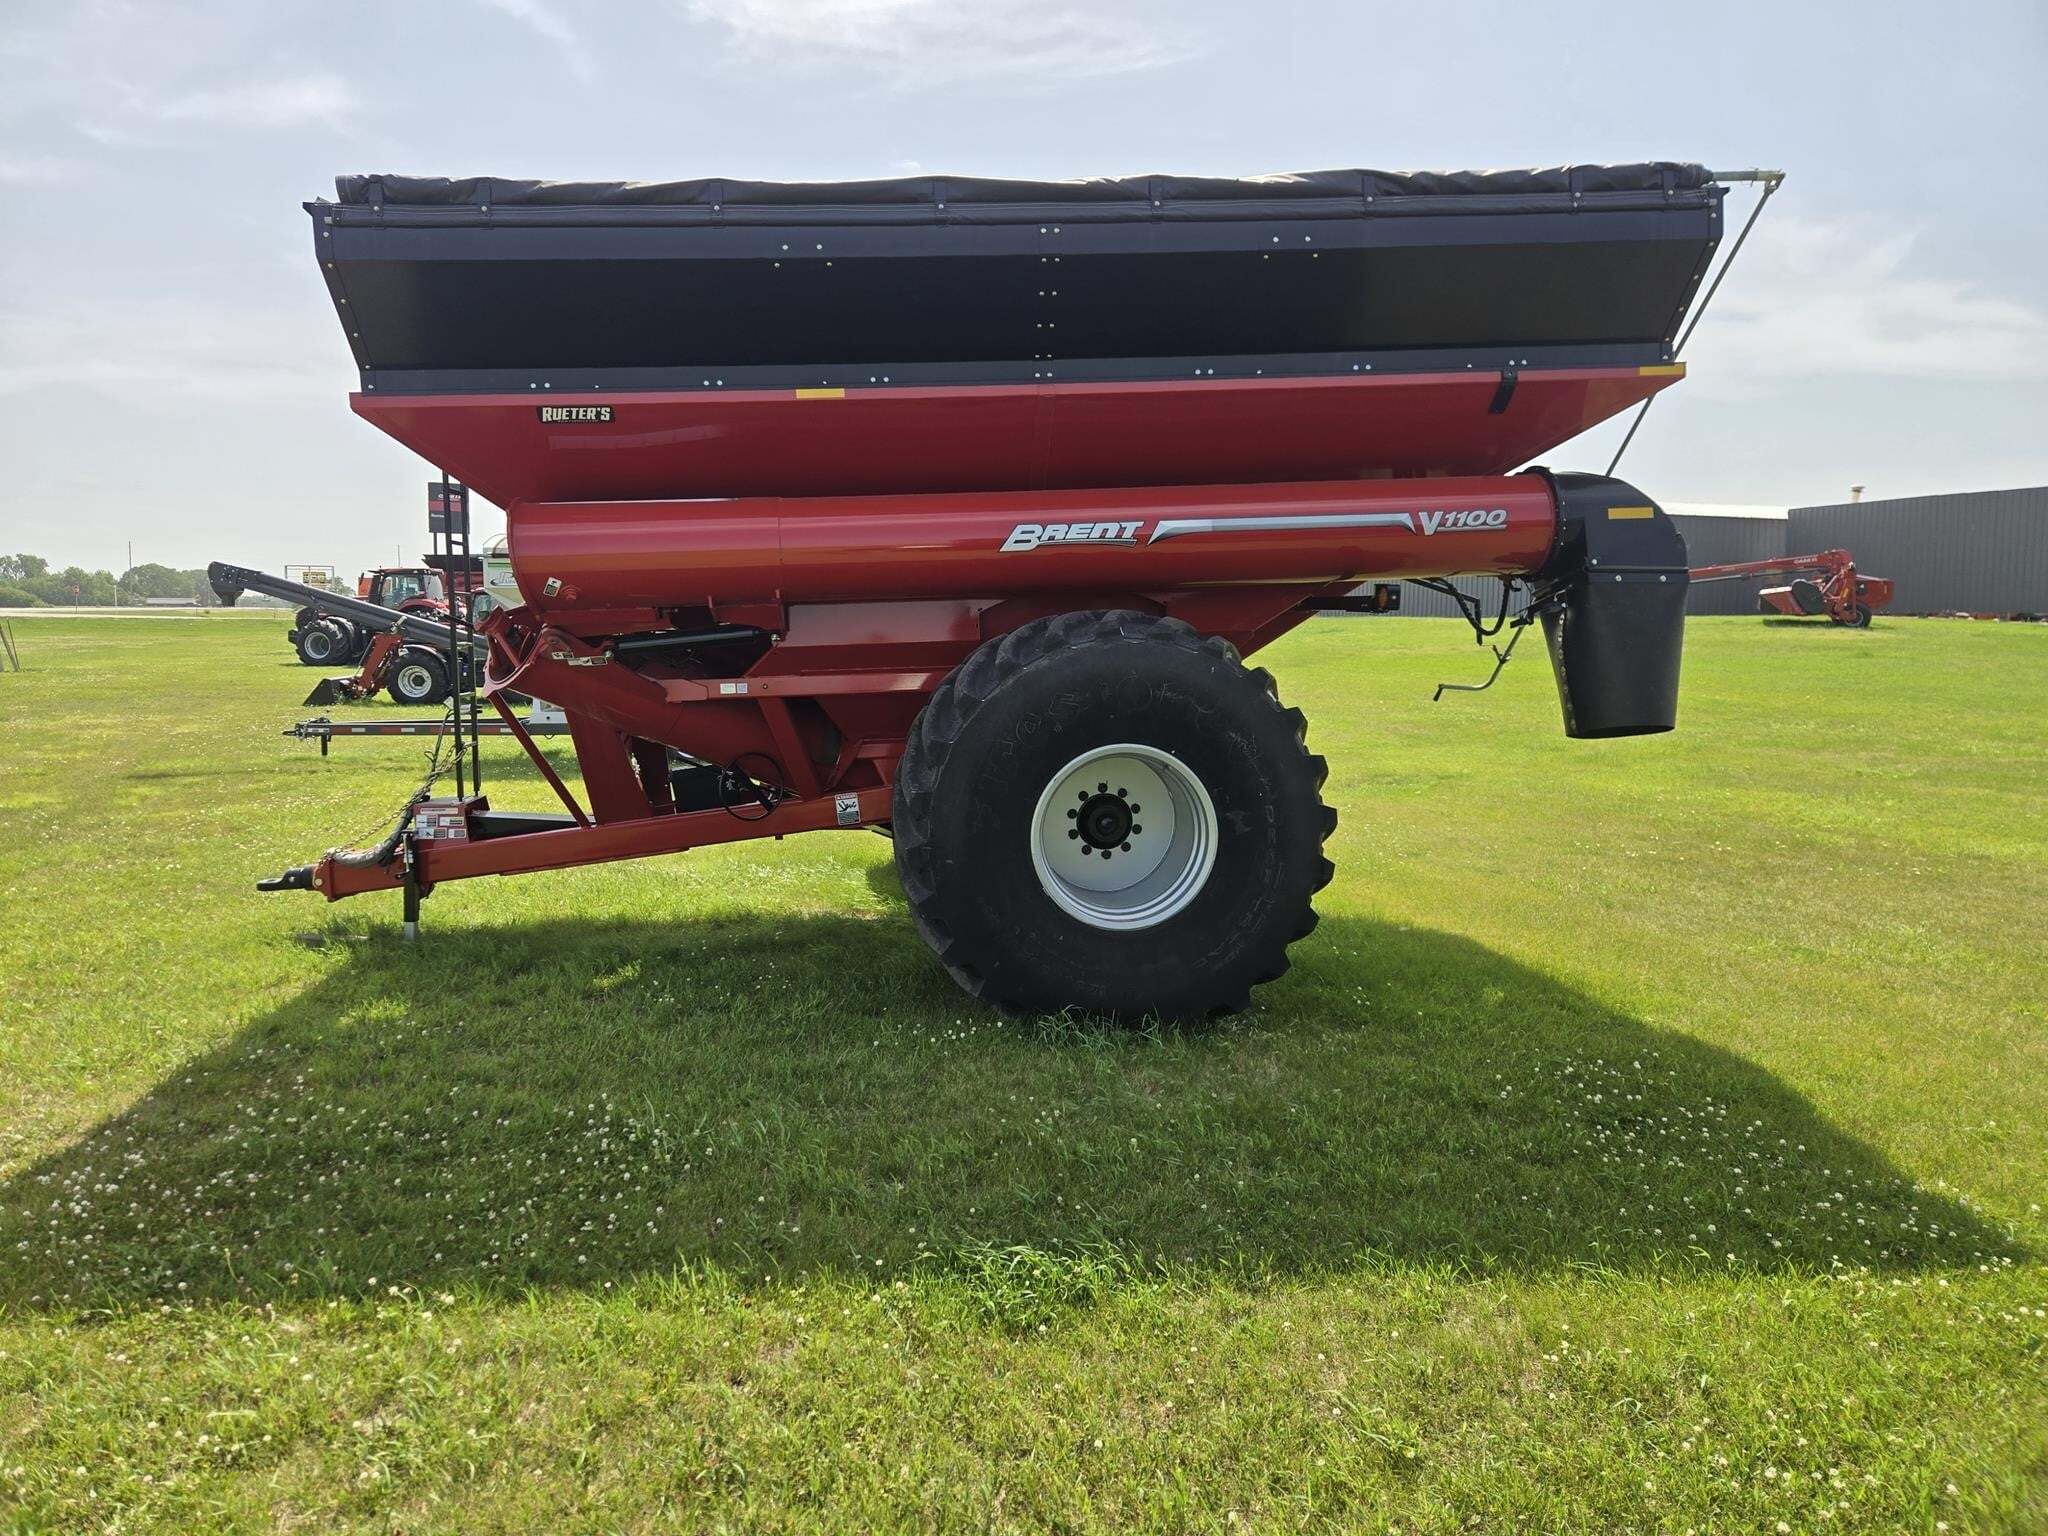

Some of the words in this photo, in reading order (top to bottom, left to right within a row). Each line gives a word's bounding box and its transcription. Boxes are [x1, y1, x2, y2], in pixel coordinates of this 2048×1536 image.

[541, 406, 611, 422] RUETER'S
[1418, 509, 1507, 536] V1100
[999, 521, 1145, 552] BRENT
